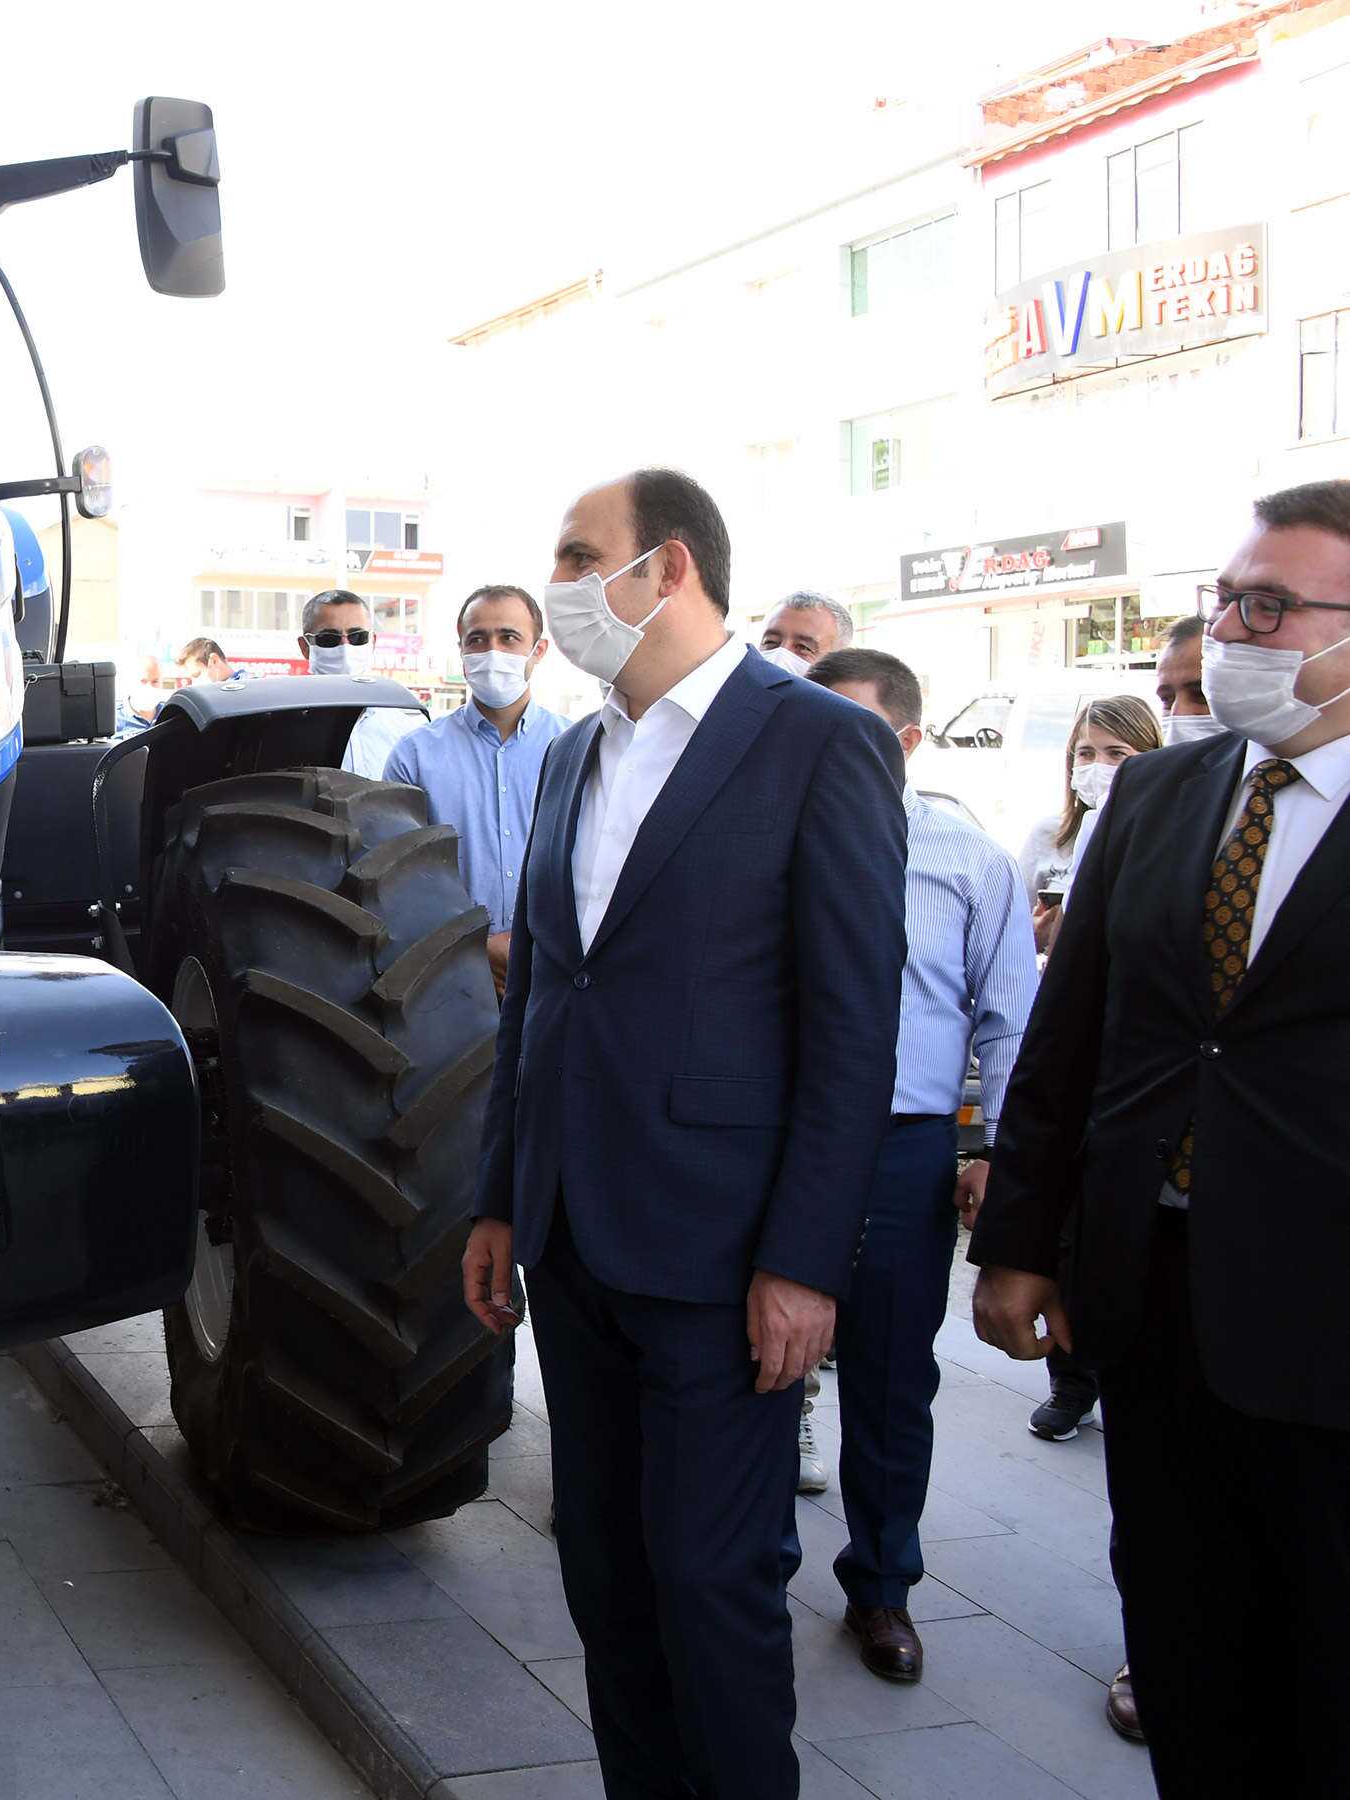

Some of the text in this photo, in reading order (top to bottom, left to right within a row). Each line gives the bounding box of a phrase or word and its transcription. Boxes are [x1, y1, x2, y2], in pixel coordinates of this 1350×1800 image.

[1146, 243, 1258, 291] ERDAĞ
[1018, 270, 1143, 357] AVM
[1146, 282, 1258, 326] TEKİN
[228, 661, 291, 677] omagene
